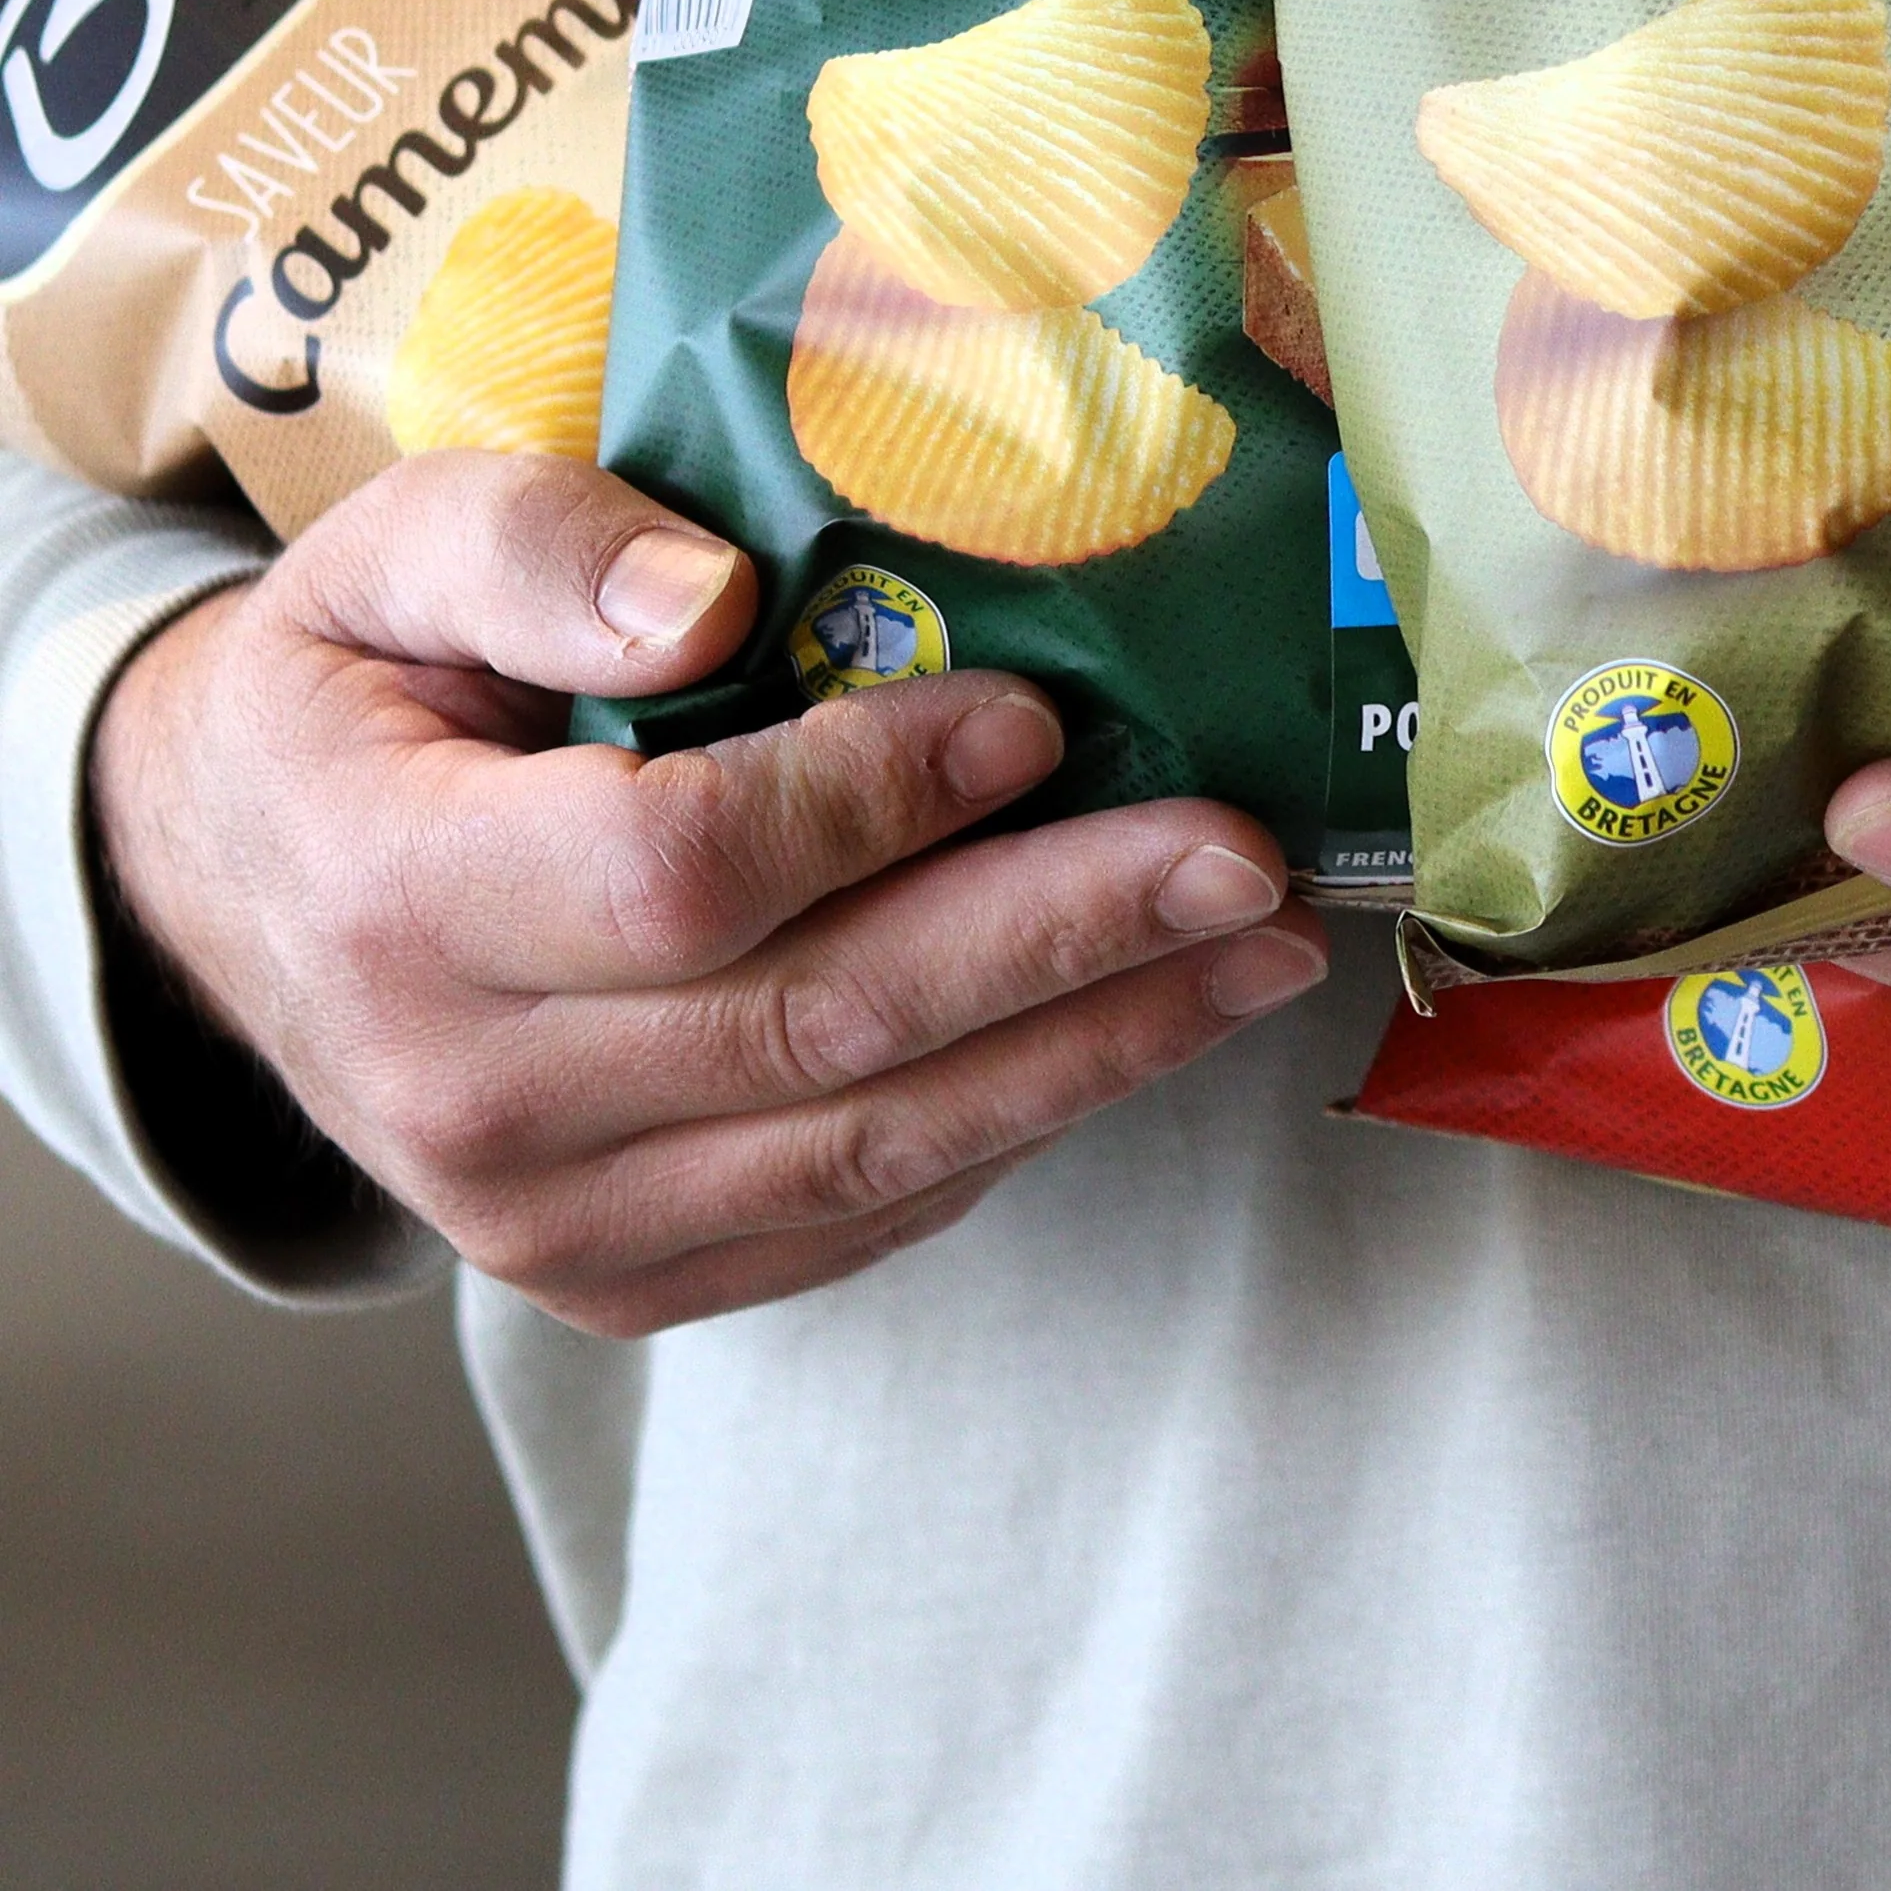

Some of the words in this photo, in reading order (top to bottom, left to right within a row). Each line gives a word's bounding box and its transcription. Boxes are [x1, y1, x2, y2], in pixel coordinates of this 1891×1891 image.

[188, 26, 418, 247] SAVEUR
[895, 588, 925, 613] EN
[1563, 669, 1659, 734] PRODUIT
[1663, 679, 1698, 708] EN
[1576, 764, 1728, 838] BRETAGNE
[1787, 986, 1808, 1018] EN
[1676, 1027, 1805, 1101] BRETAGNE
